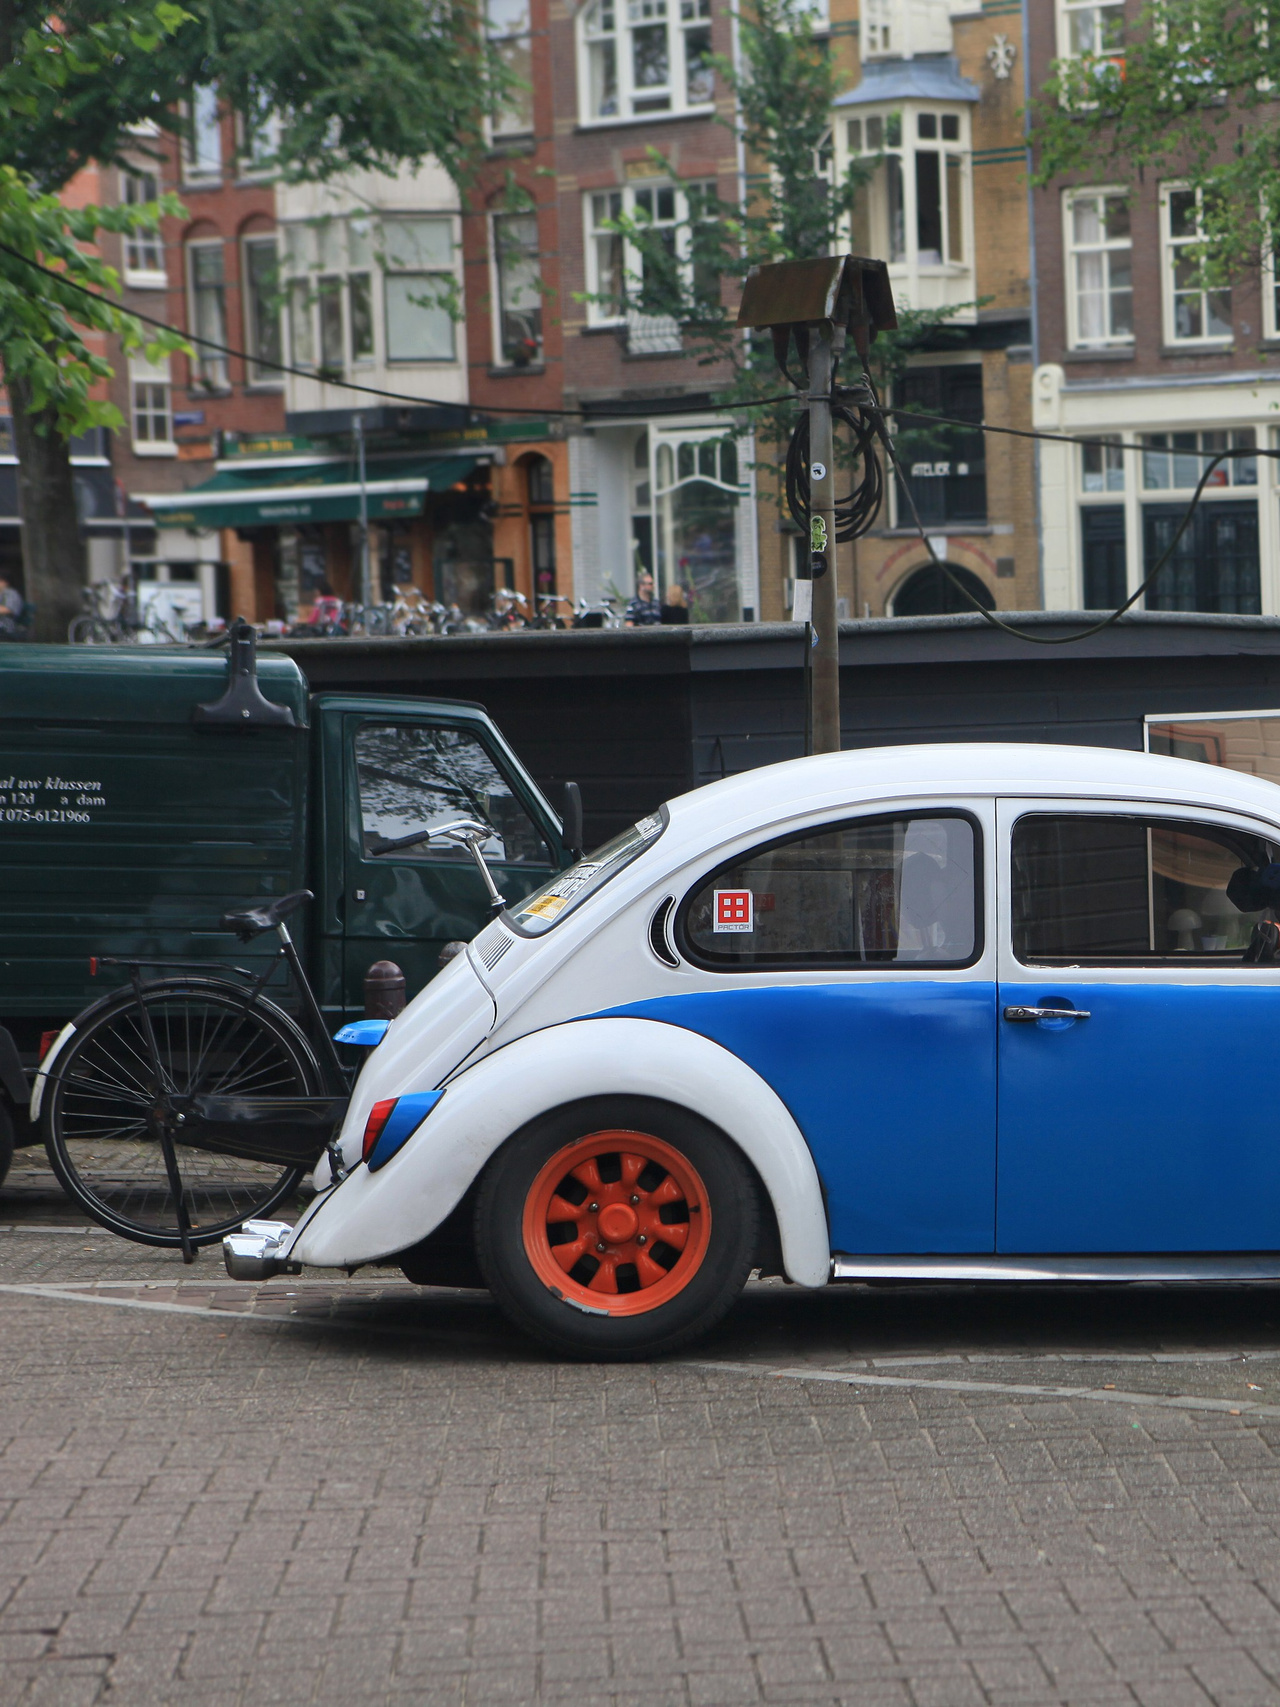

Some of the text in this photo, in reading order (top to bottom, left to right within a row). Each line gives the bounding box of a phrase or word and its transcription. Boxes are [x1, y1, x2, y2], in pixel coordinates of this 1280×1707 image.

[18, 780, 42, 790] uw
[45, 776, 101, 791] klussen
[76, 793, 106, 806] dam
[6, 808, 91, 823] 075-6121966
